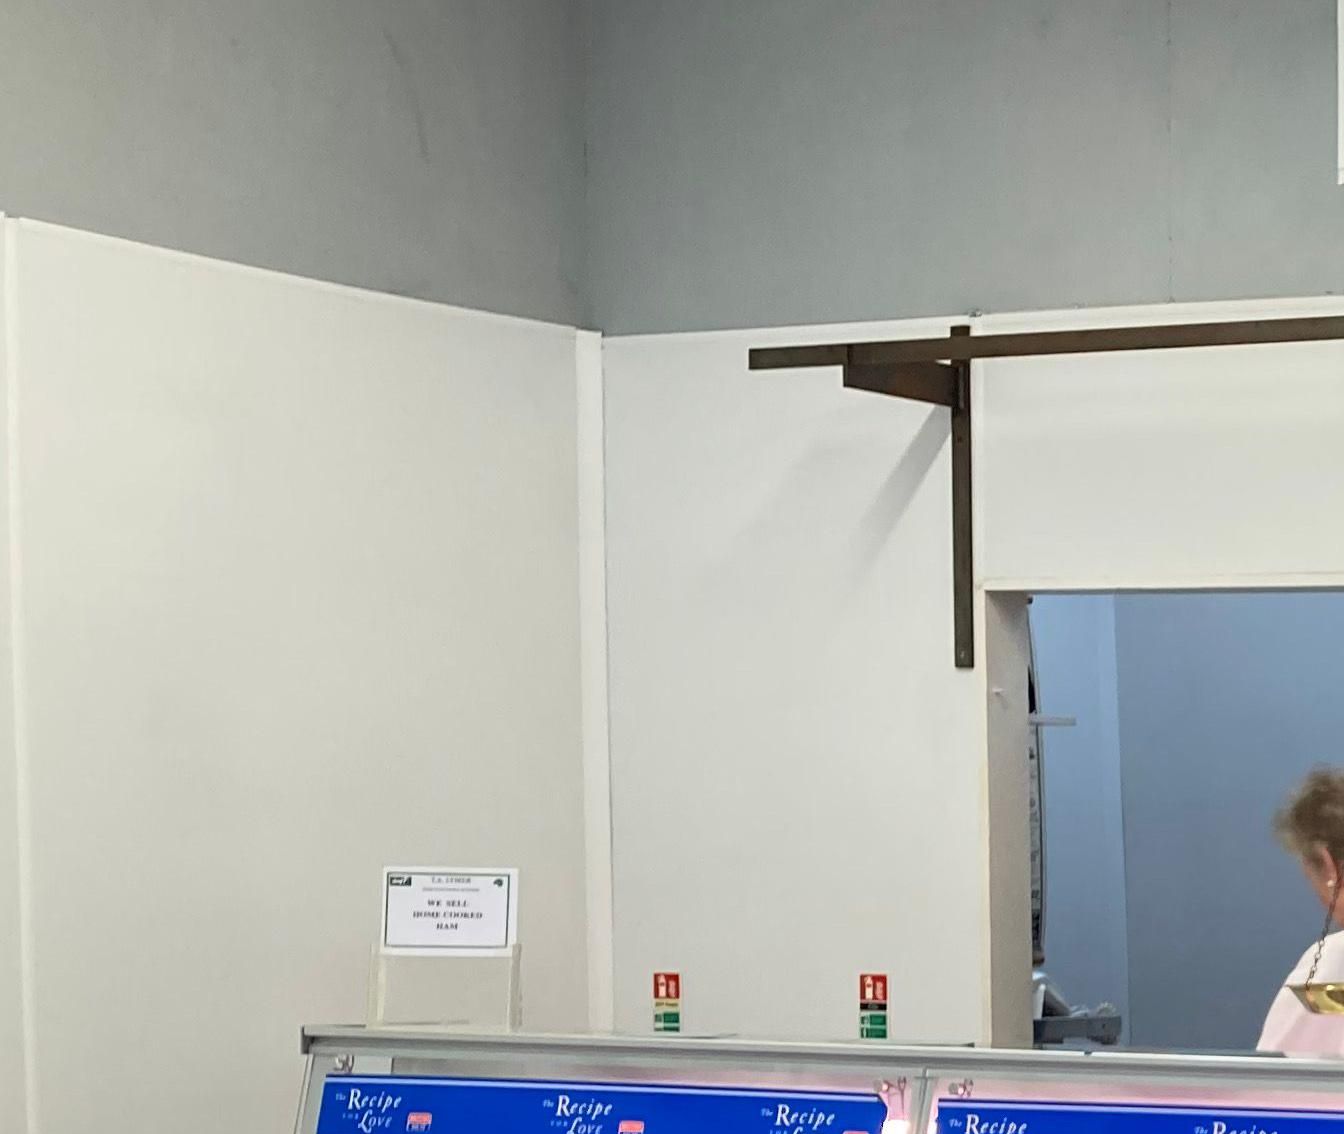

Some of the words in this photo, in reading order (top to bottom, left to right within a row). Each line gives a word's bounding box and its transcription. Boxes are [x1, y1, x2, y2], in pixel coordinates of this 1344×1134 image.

[427, 899, 442, 907] WE
[446, 899, 469, 907] SELL
[412, 911, 441, 919] HOME
[442, 911, 484, 919] COOKED
[436, 922, 459, 930] HAM
[347, 1088, 403, 1113] Recipe
[556, 1095, 613, 1121] Recipe
[775, 1104, 835, 1130] Recipe
